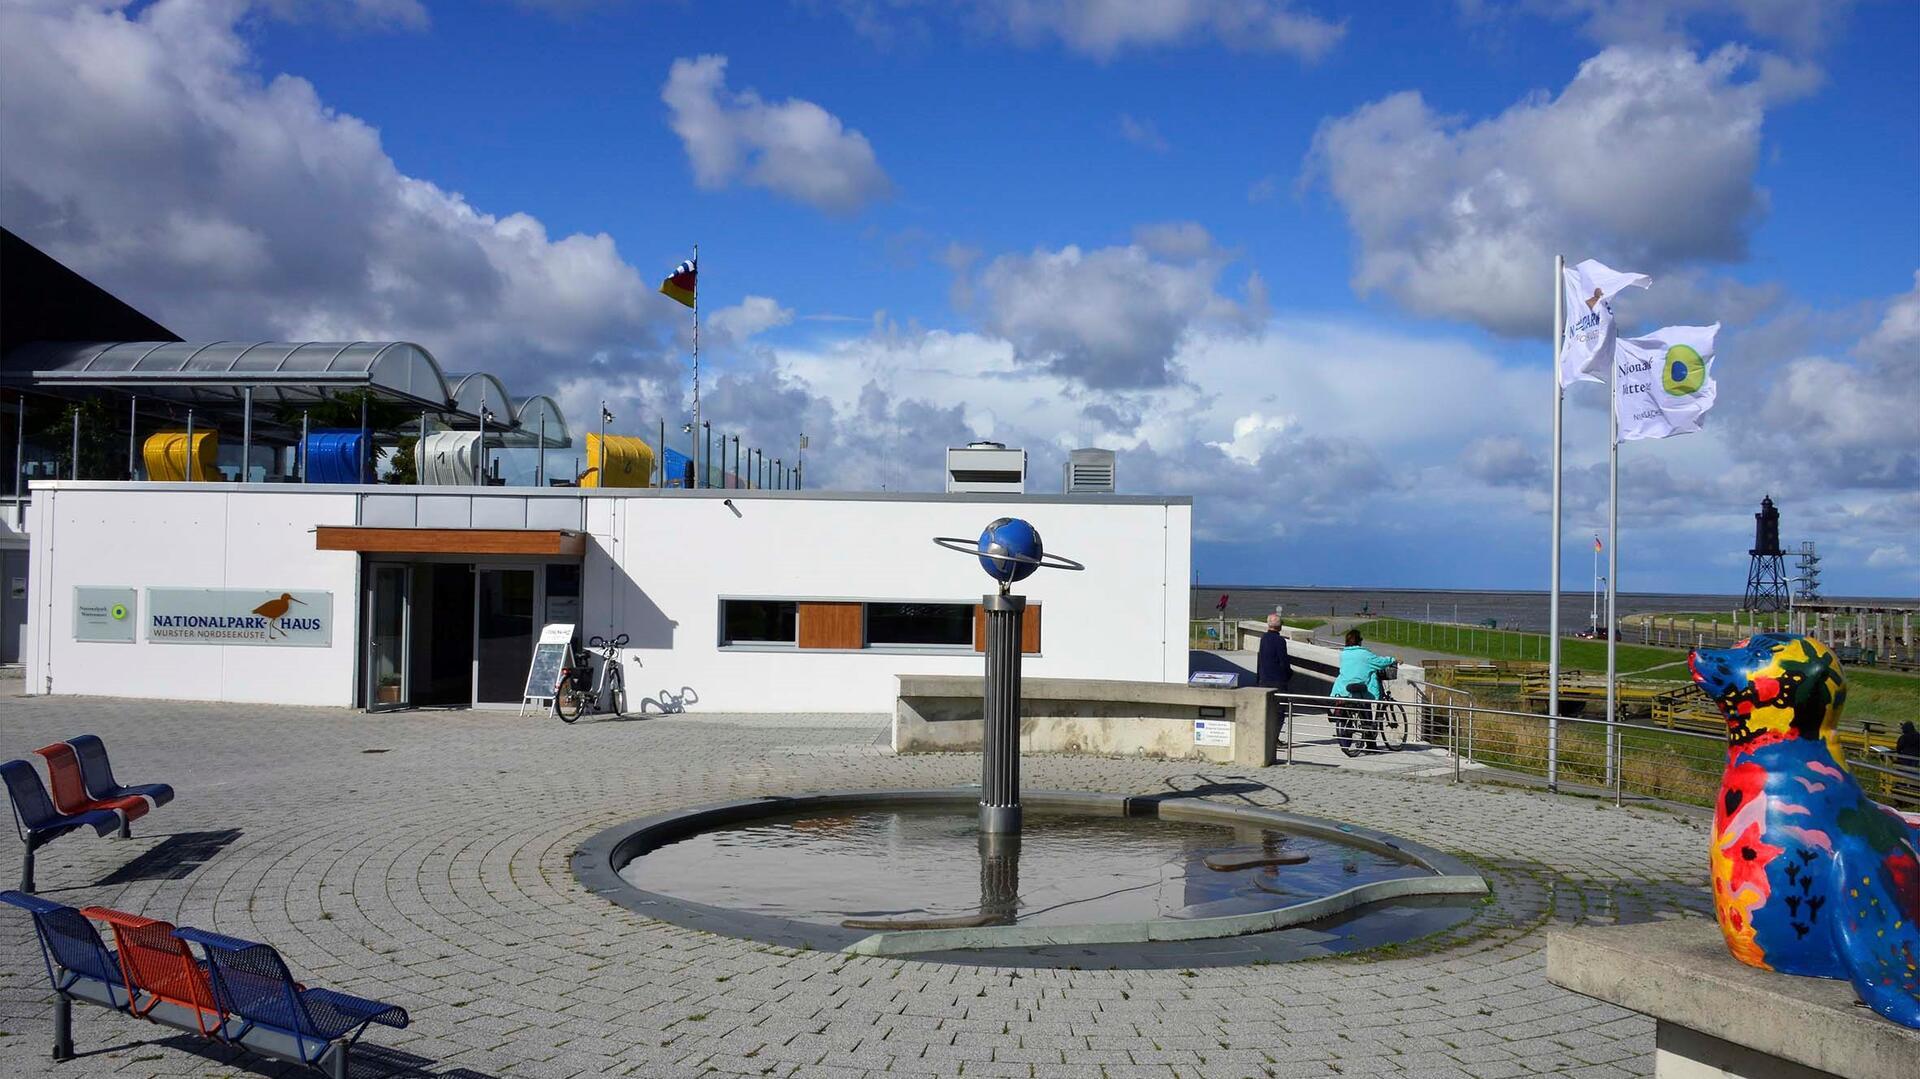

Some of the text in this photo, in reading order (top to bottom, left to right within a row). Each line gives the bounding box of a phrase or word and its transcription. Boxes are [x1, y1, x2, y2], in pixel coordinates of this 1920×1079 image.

[436, 451, 445, 464] 1
[153, 615, 321, 630] NATIONALPARK- HAUS
[153, 629, 194, 638] WURSTER
